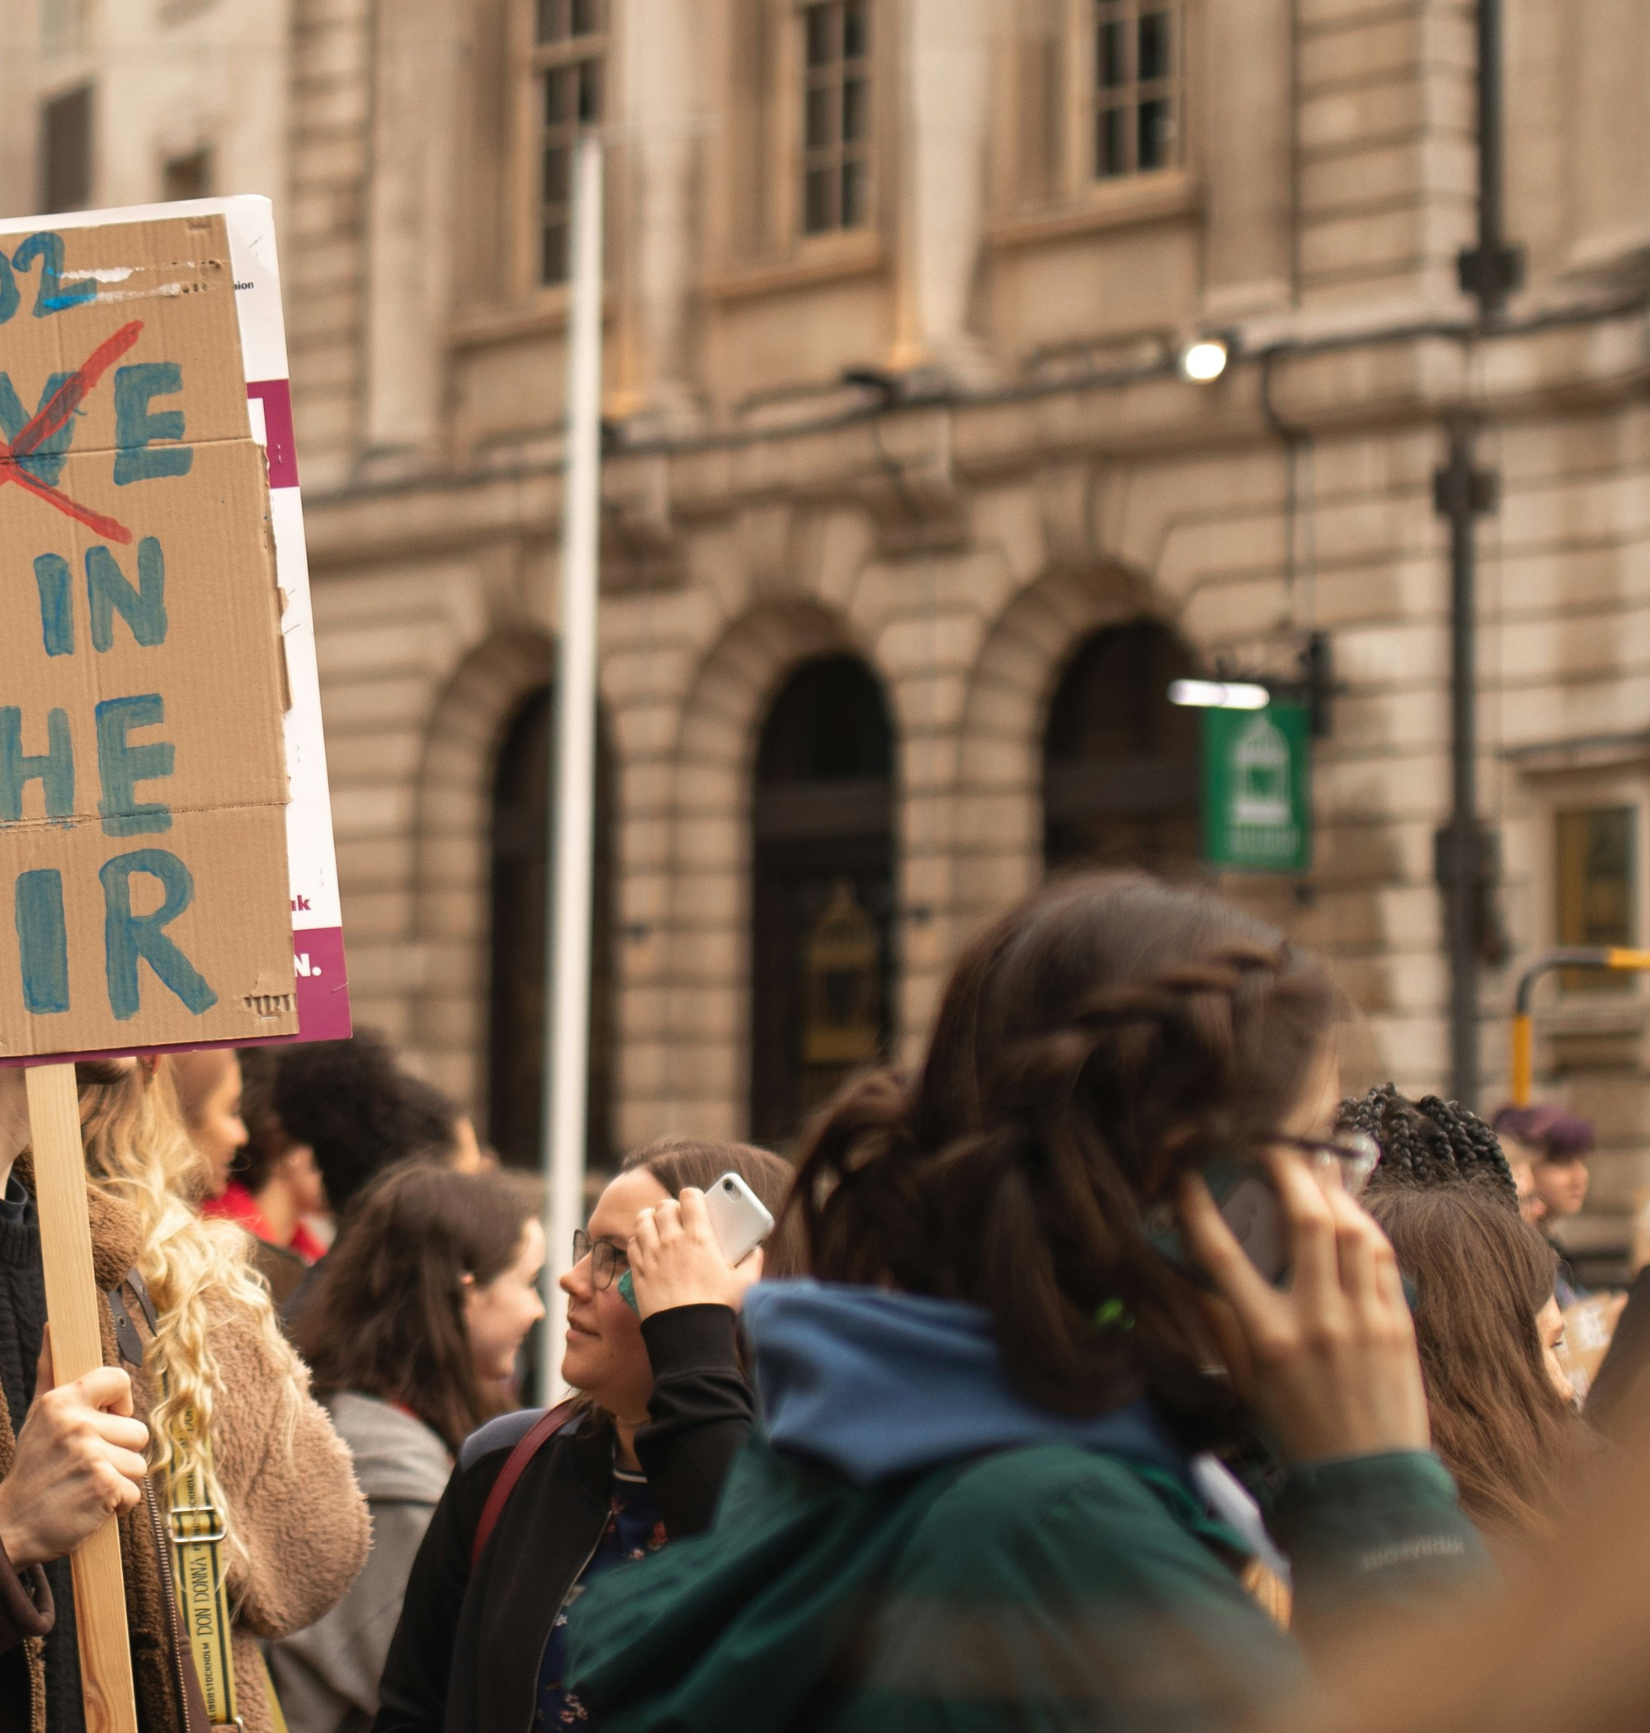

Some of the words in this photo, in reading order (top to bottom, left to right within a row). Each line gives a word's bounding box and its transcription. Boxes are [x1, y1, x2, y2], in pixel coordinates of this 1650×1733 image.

[33, 536, 168, 657] IN
[190, 1557, 210, 1603] DONNA
[195, 1608, 213, 1636] DON
